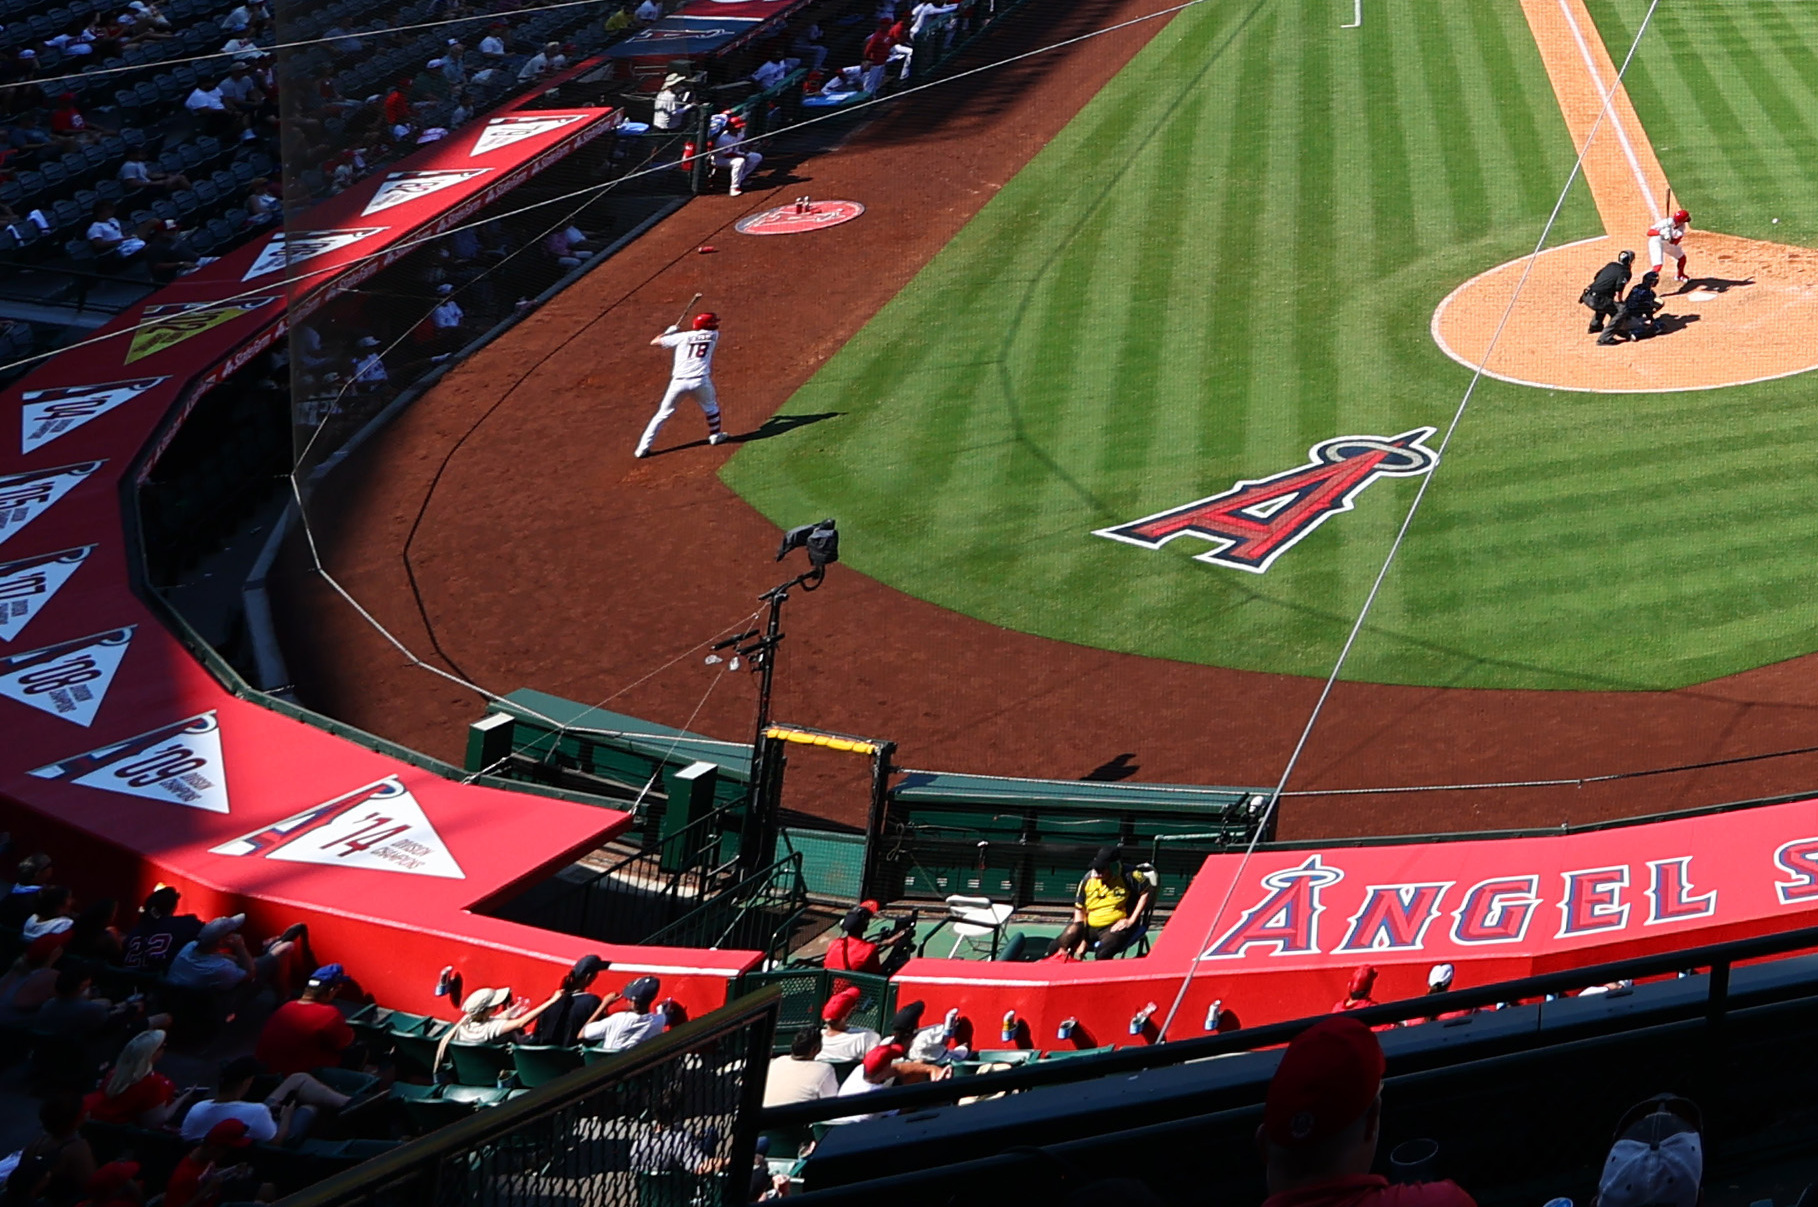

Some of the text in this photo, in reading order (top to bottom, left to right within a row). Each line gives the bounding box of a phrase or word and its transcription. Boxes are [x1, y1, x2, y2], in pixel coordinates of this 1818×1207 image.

[687, 342, 710, 359] 18
[18, 653, 103, 695] '08
[114, 743, 207, 788] '09
[320, 811, 413, 858] '14
[1200, 850, 1718, 962] ANGEL
